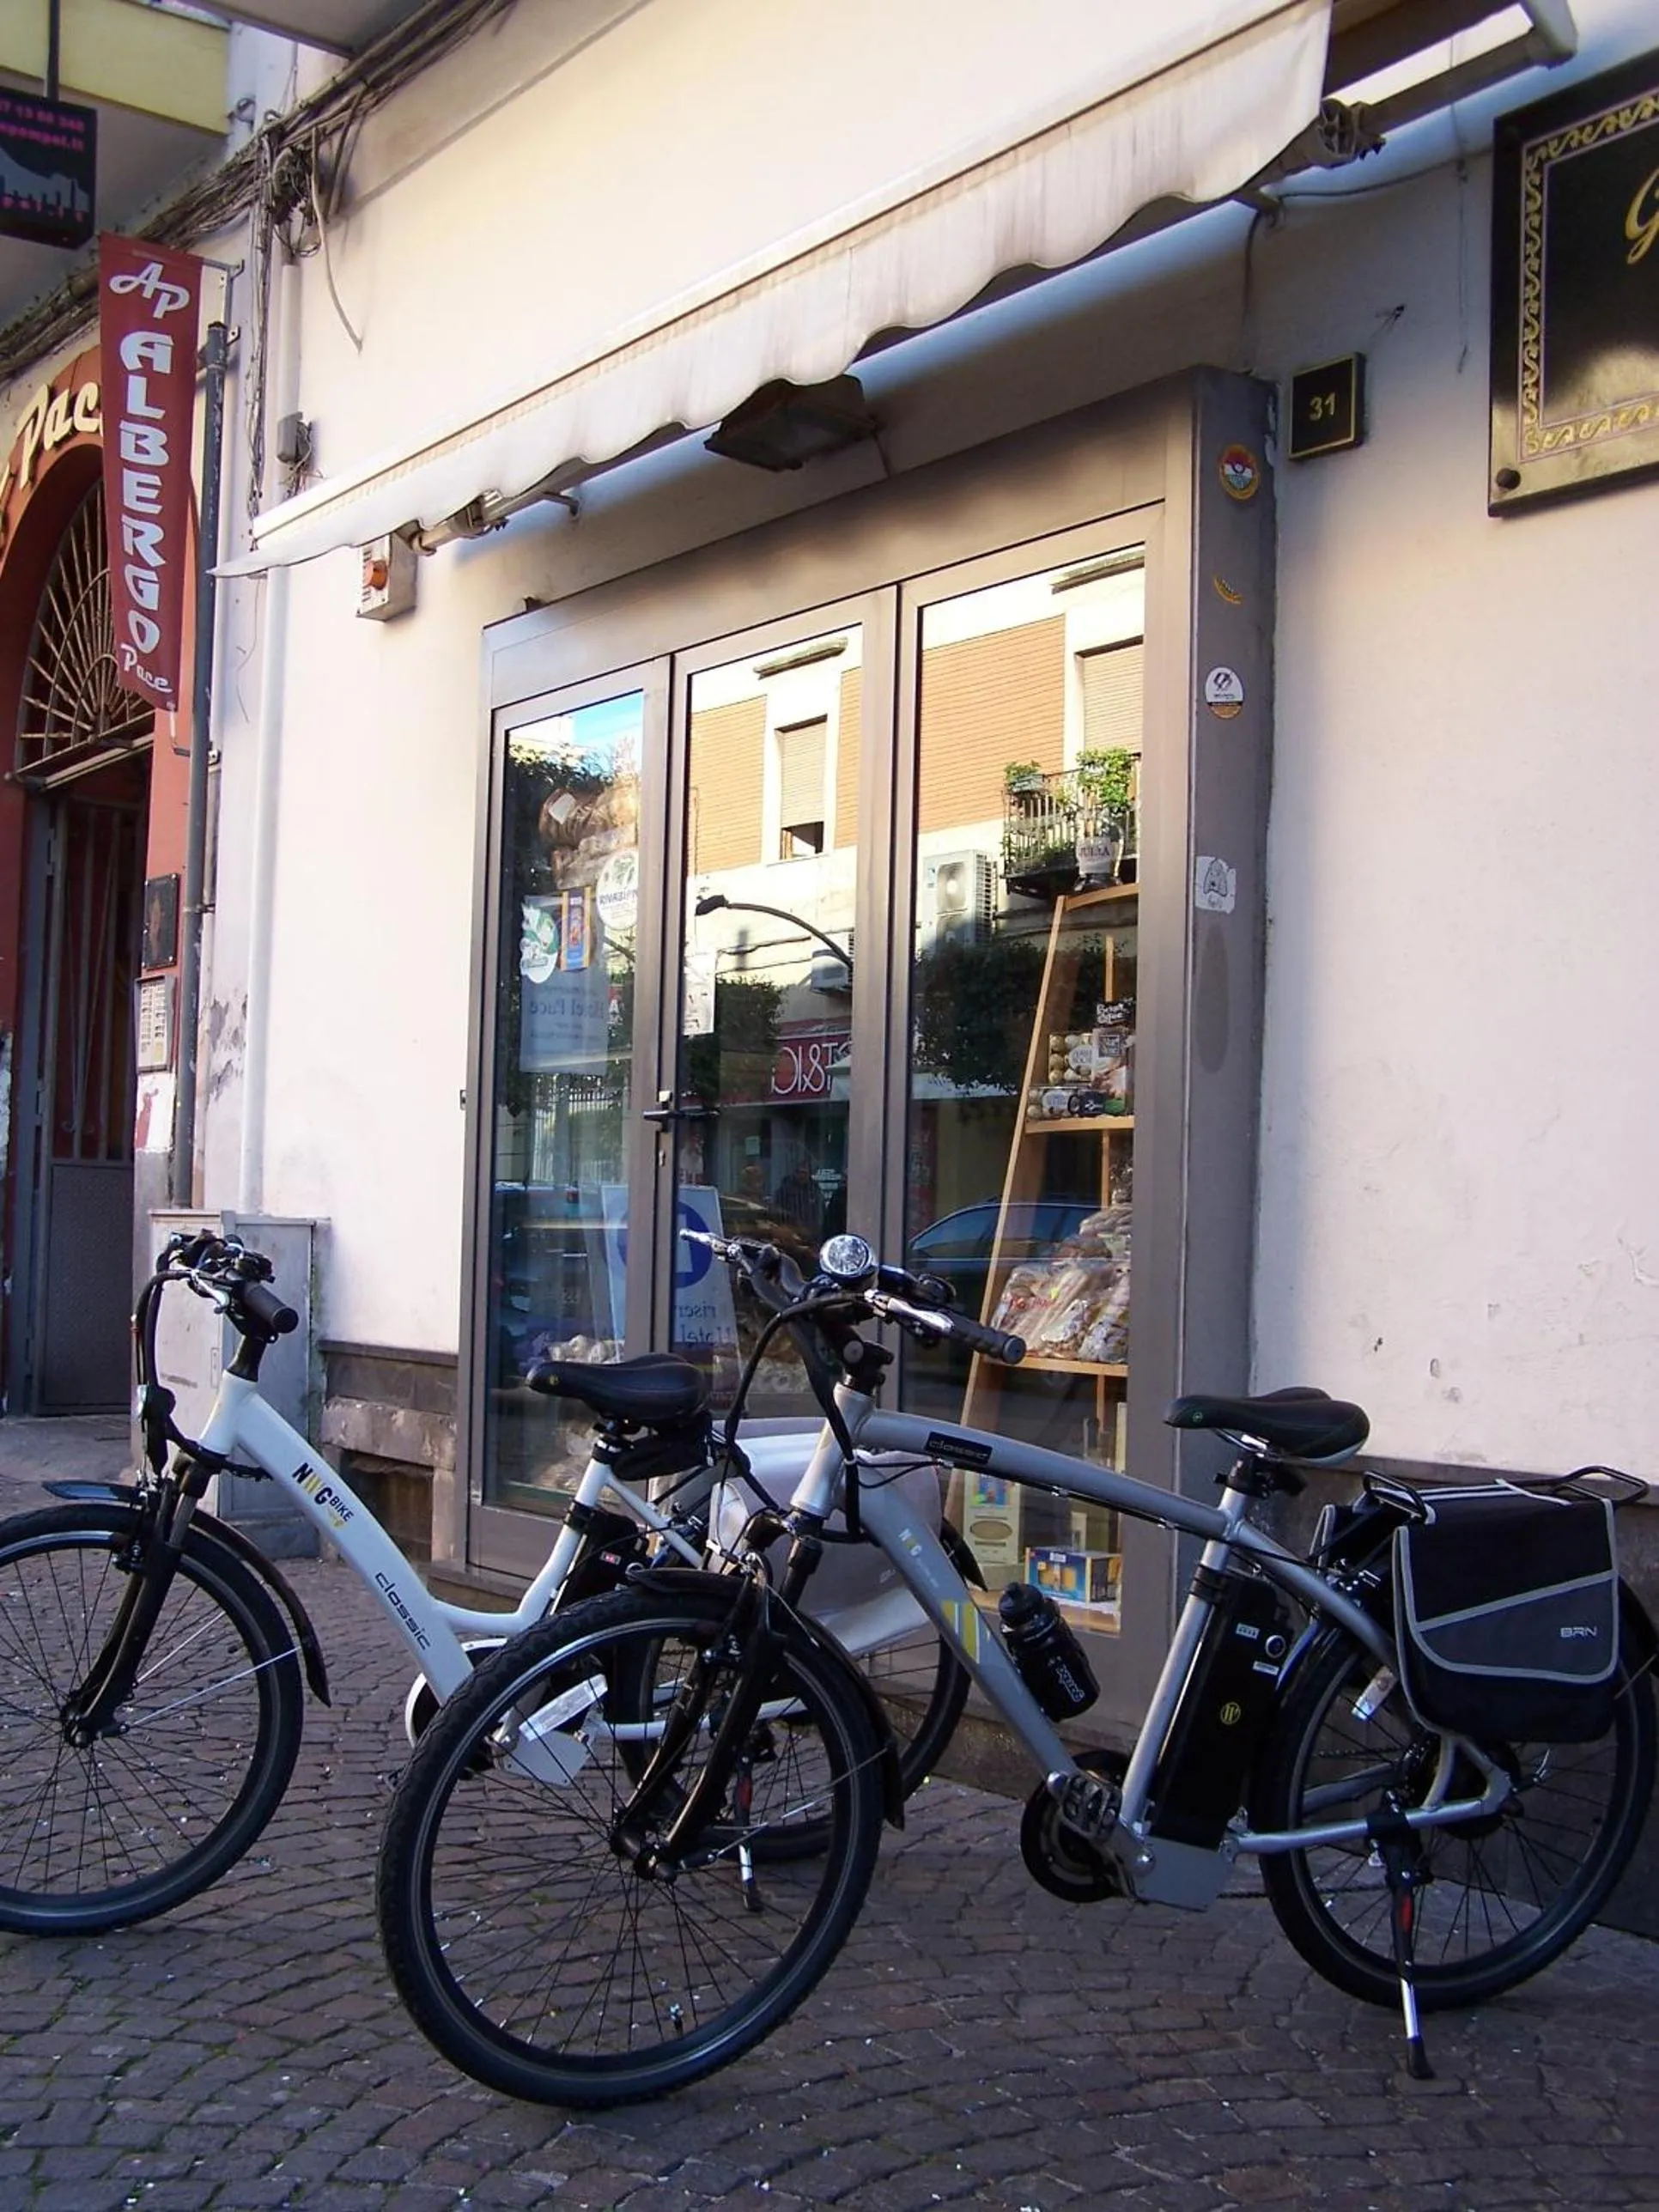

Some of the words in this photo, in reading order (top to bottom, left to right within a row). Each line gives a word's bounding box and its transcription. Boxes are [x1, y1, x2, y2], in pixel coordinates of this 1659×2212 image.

[1309, 391, 1336, 422] 31
[16, 381, 103, 489] Pac
[119, 331, 174, 653] ALBERGO
[120, 644, 173, 693] Pace
[329, 1496, 355, 1522] BIKE
[374, 1571, 432, 1651] classic
[1559, 1626, 1598, 1638] BRN
